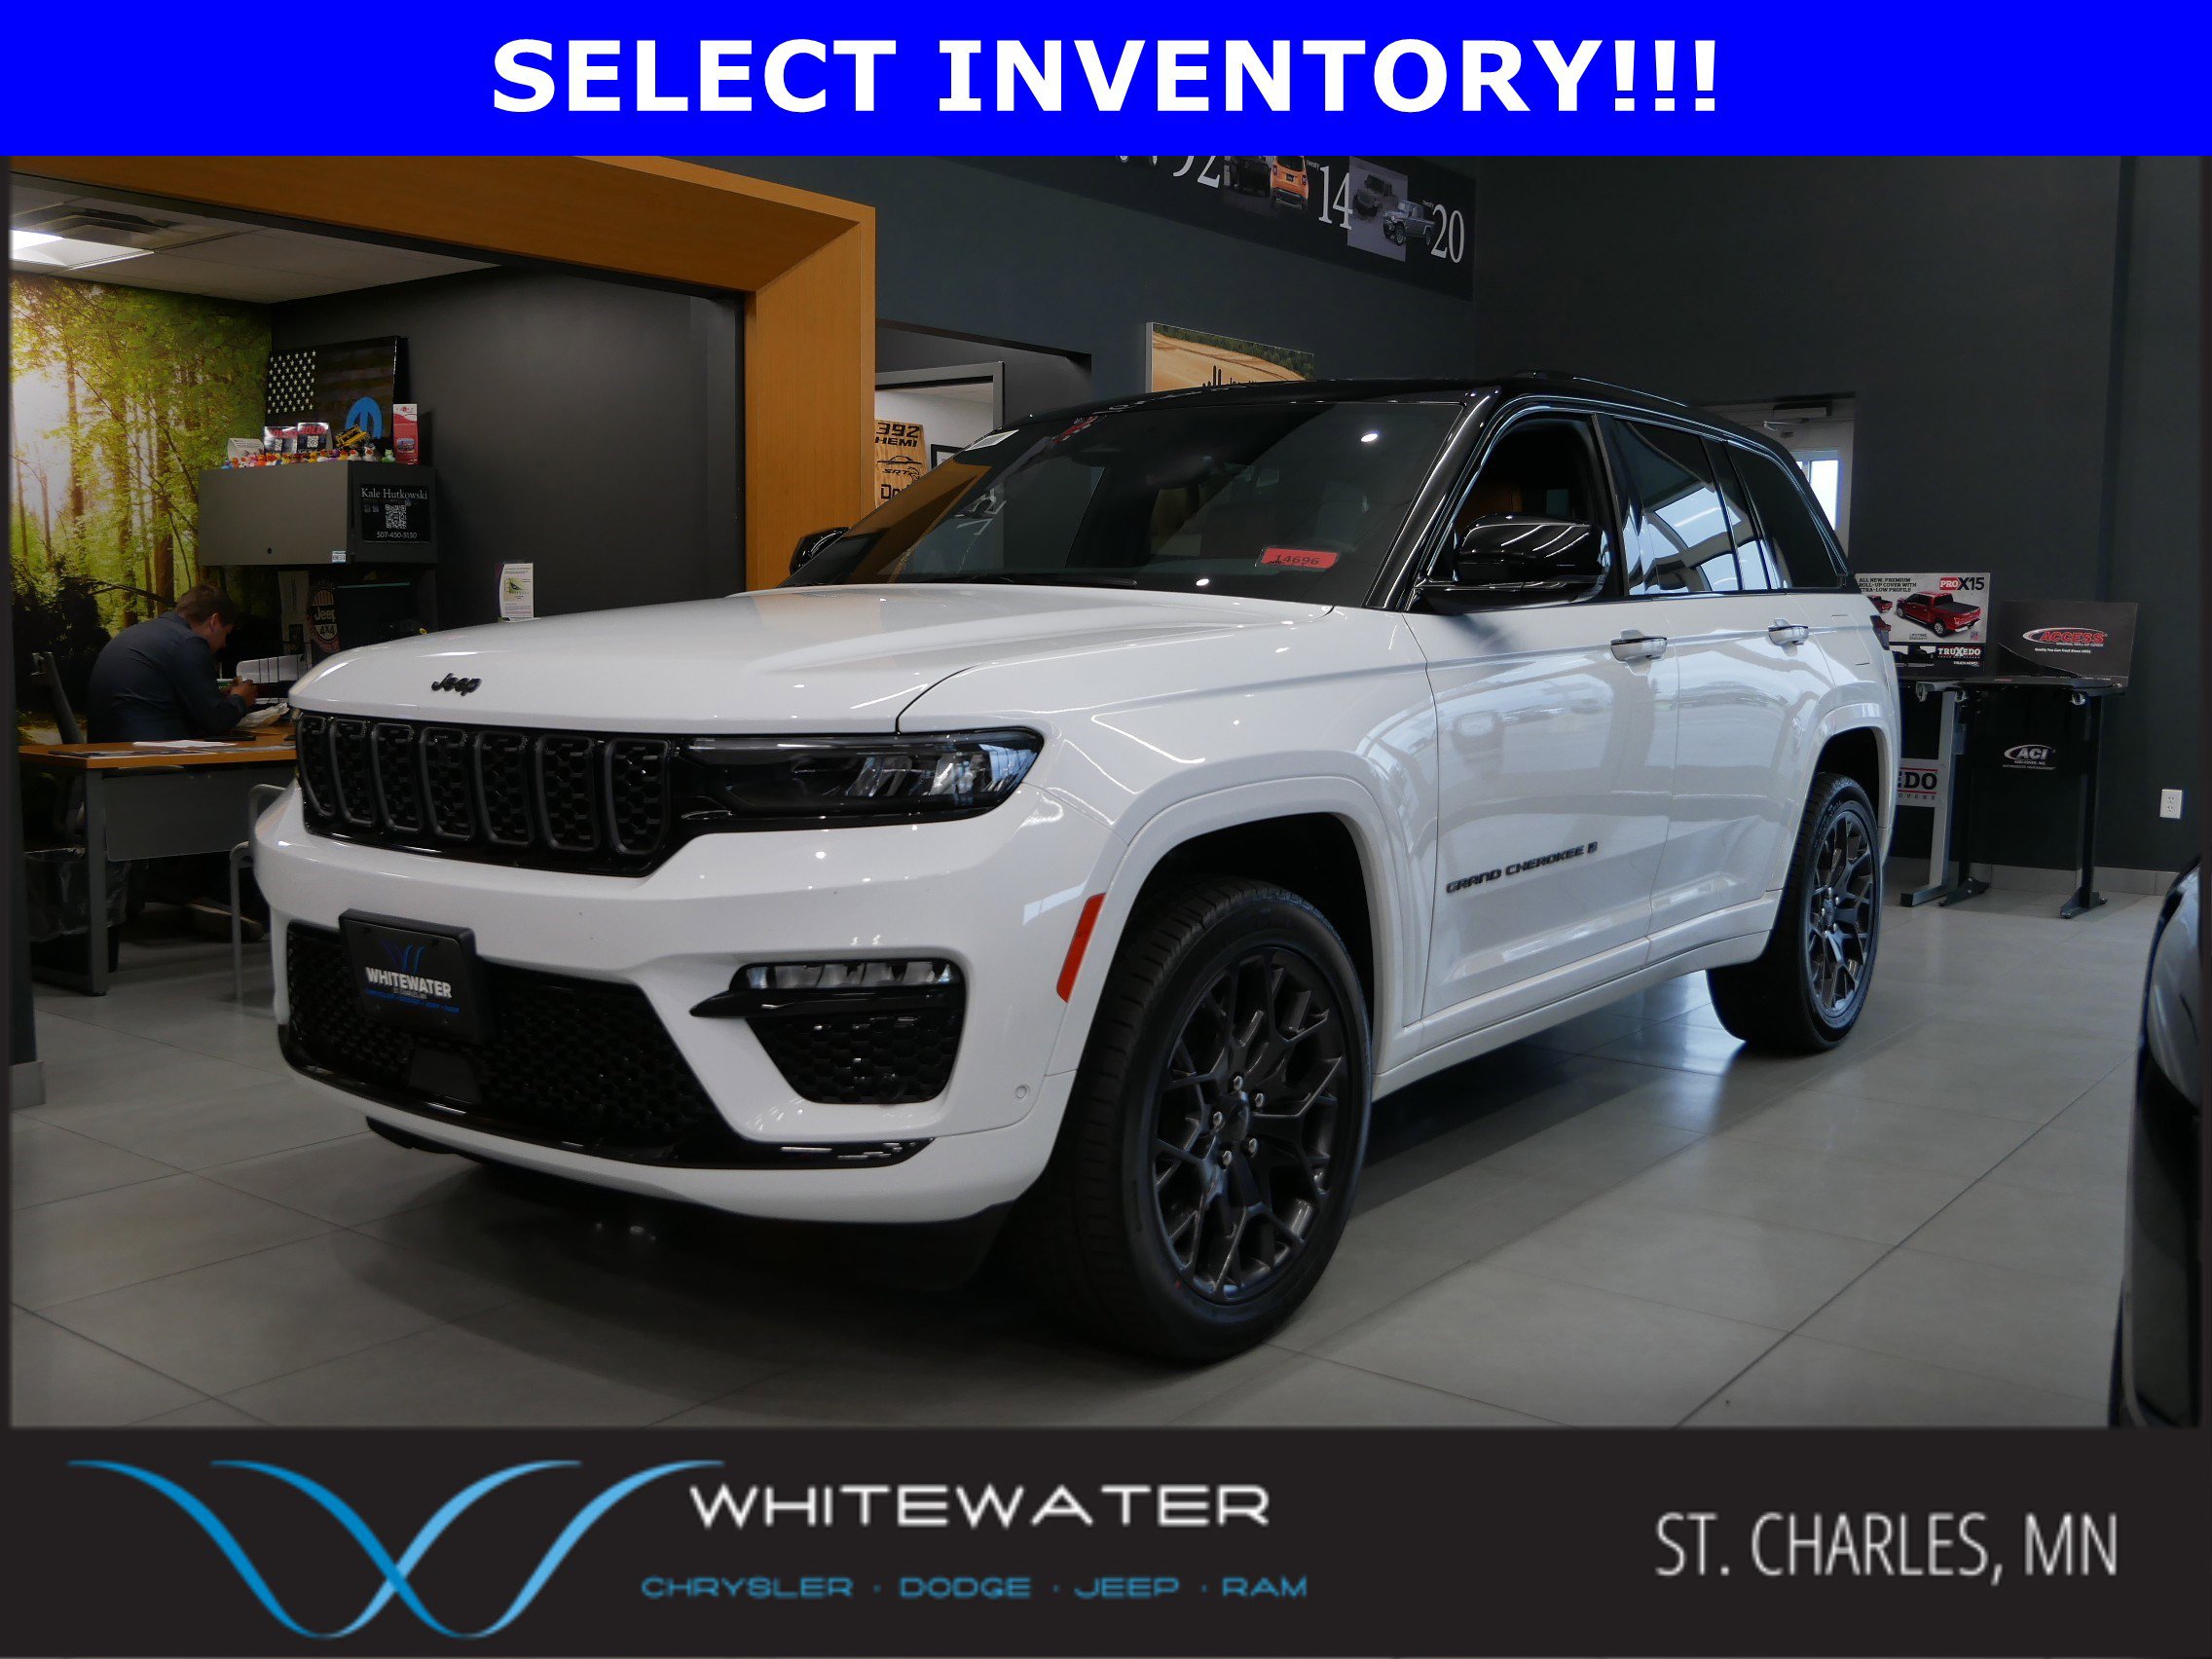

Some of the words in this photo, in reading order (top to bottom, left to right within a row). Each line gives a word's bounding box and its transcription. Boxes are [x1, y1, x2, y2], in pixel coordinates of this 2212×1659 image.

[1318, 165, 1353, 230] 14
[1430, 203, 1465, 264] 20
[875, 422, 920, 438] 392
[875, 436, 918, 447] HEMI
[361, 488, 381, 498] Kale
[383, 488, 428, 500] Hutkowski
[1940, 579, 1959, 588] PRO
[1958, 577, 1985, 591] X15
[2040, 631, 2107, 644] ACCESS
[1937, 646, 1981, 657] TRUXEDO
[431, 672, 483, 697] Jeep
[2016, 747, 2048, 760] ACI
[1446, 867, 1502, 894] GRAND
[1505, 844, 1585, 875] CHEROKEE
[365, 966, 453, 1000] WHITEWATER
